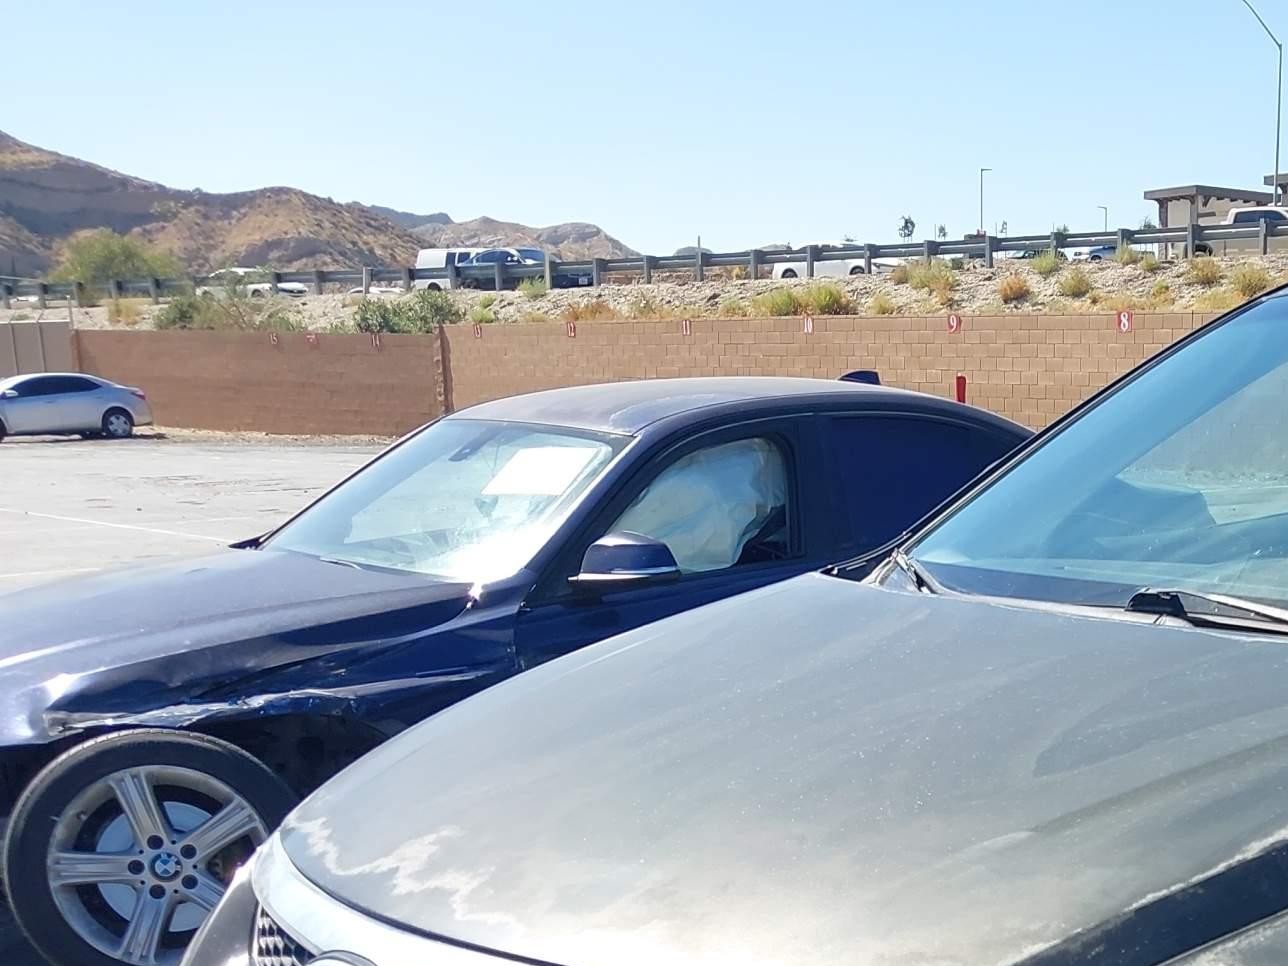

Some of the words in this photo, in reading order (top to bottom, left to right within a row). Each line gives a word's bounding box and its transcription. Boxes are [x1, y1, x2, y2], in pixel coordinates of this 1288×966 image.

[682, 319, 690, 336] 11
[803, 317, 813, 334] 10
[949, 314, 958, 333] 9
[1119, 311, 1129, 332] 8
